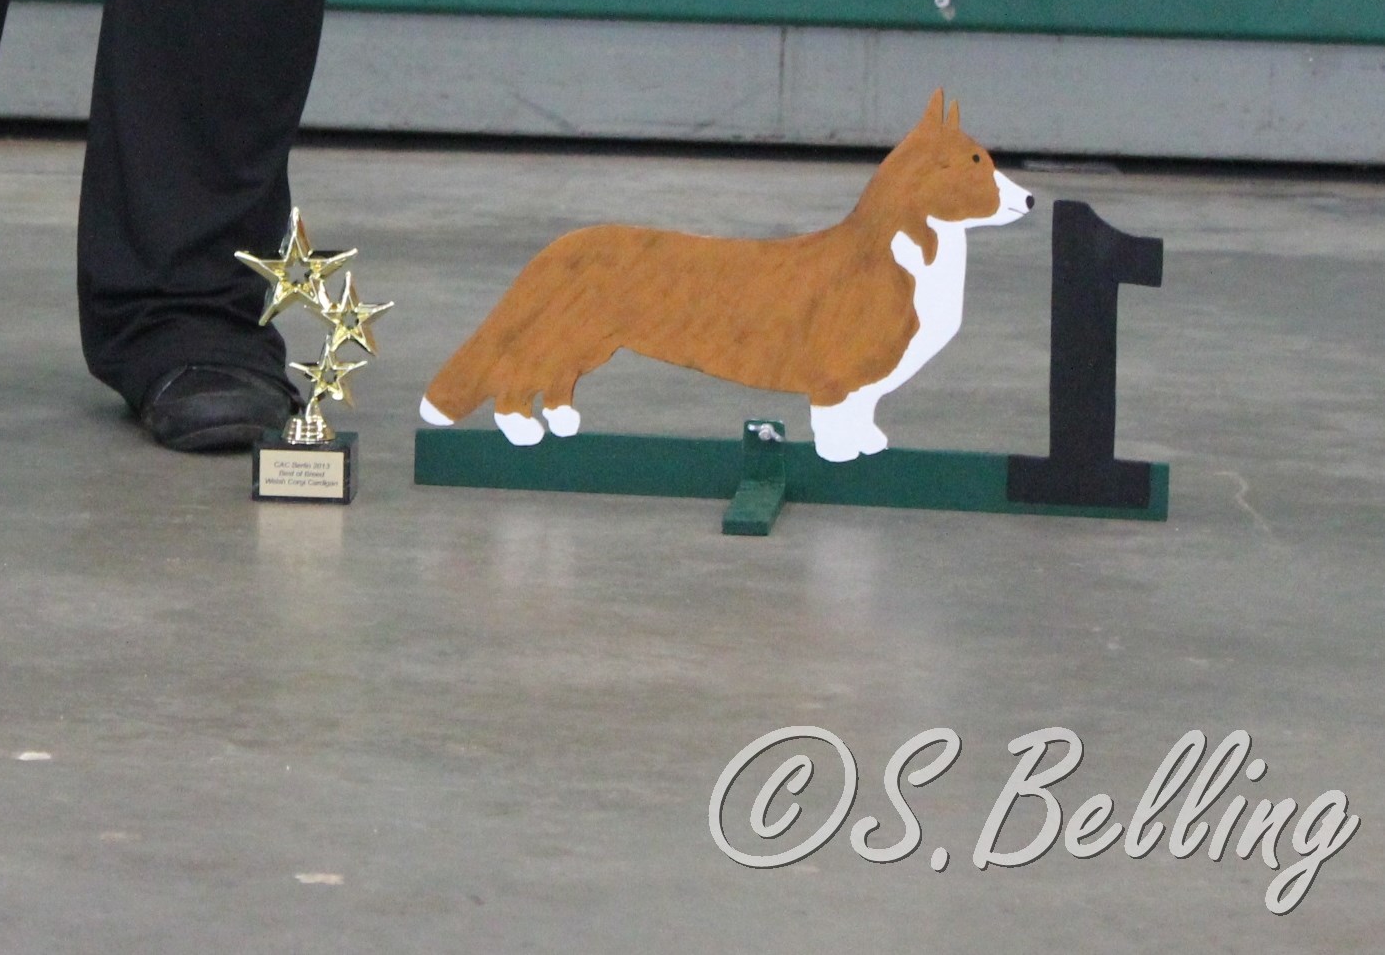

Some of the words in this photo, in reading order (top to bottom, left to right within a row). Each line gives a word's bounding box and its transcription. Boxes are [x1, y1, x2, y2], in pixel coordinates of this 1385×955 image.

[291, 461, 312, 469] Berlin
[313, 462, 331, 470] 2013
[265, 477, 286, 485] Welsh
[287, 478, 306, 486] Corgi
[308, 479, 338, 487] Cardigan
